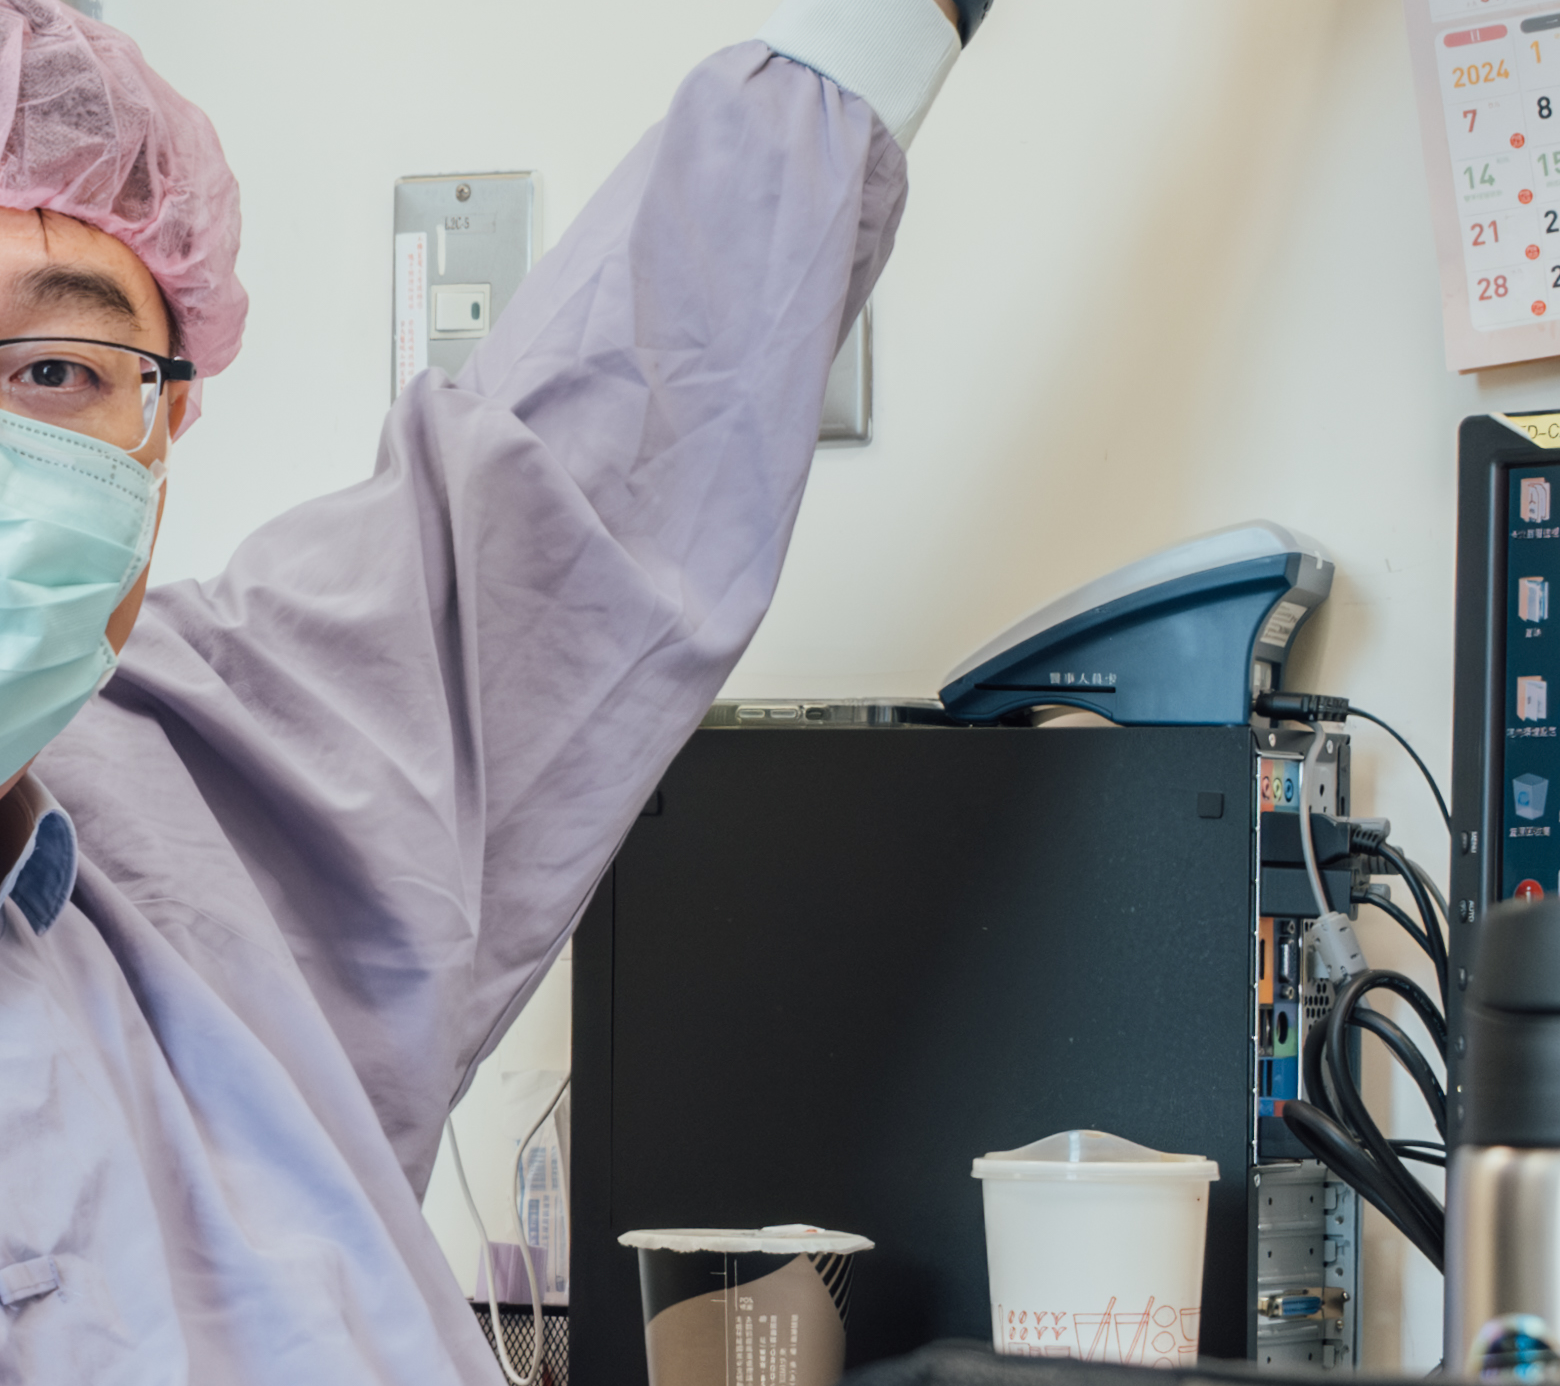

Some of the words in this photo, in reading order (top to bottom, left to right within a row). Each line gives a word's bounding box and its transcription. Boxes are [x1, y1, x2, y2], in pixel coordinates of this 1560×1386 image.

[1452, 59, 1510, 88] 2024
[1530, 40, 1542, 64] 1
[1463, 163, 1496, 190] 14
[1477, 275, 1509, 301] 28
